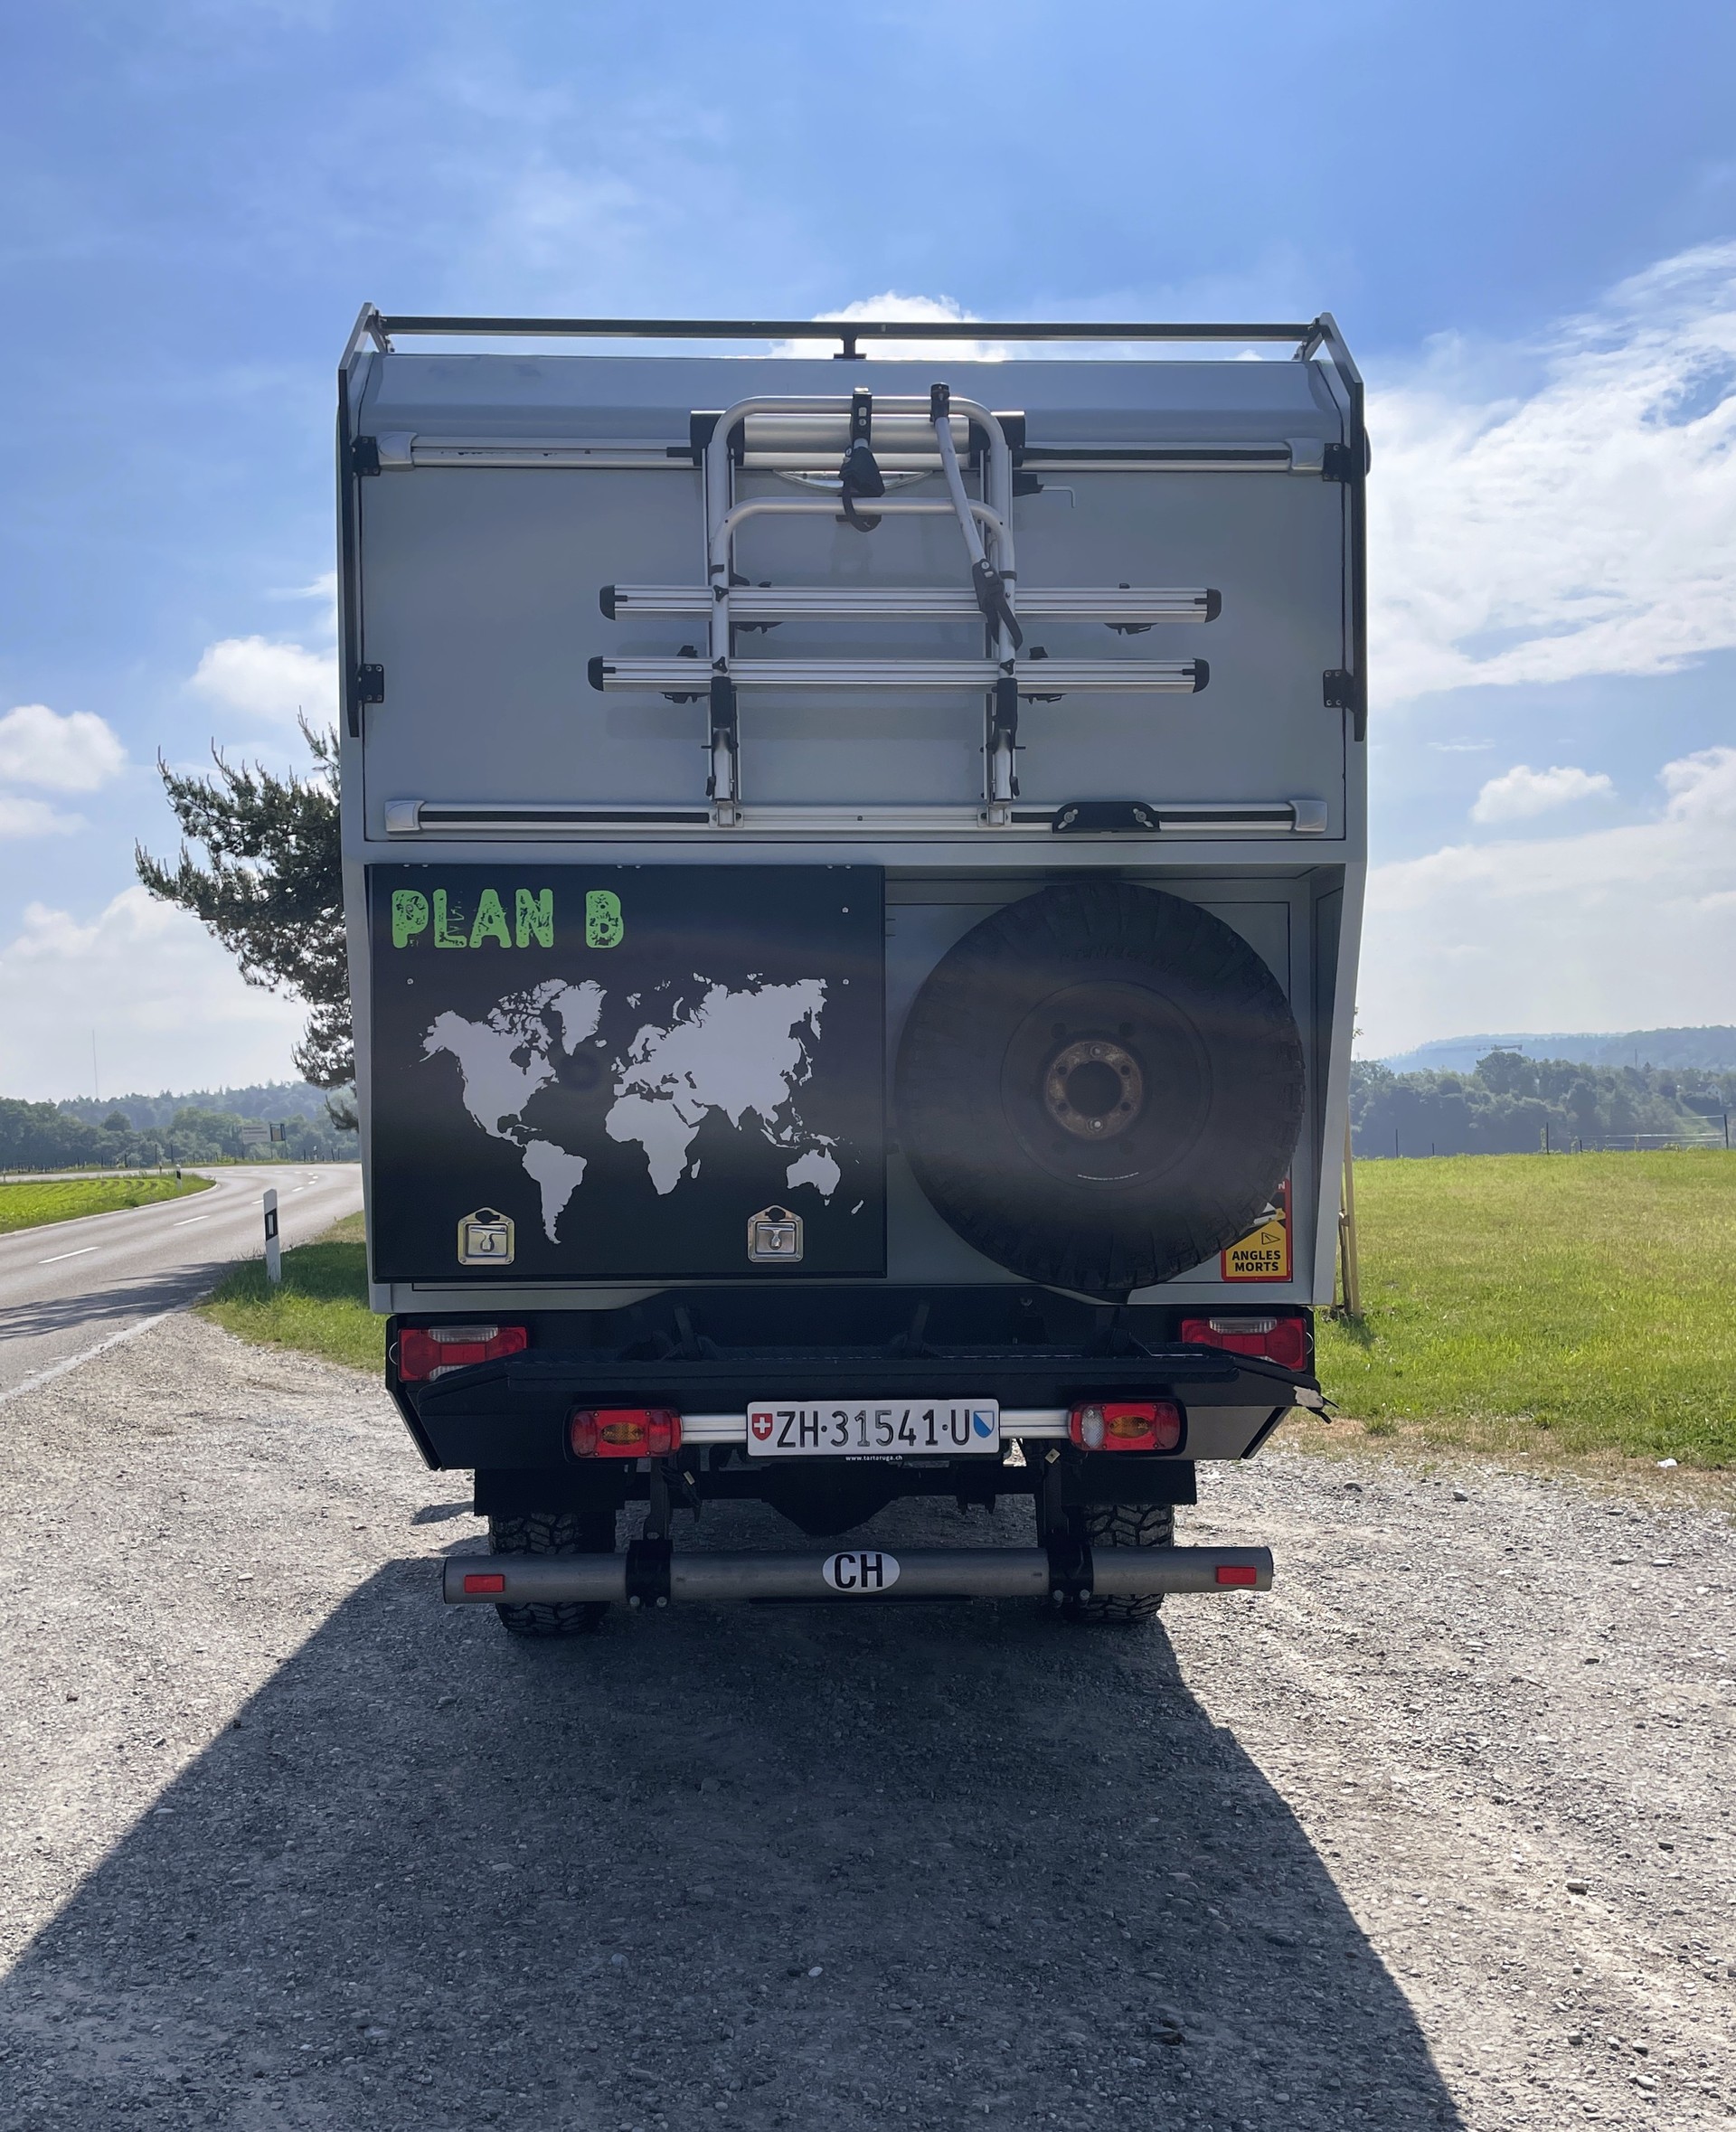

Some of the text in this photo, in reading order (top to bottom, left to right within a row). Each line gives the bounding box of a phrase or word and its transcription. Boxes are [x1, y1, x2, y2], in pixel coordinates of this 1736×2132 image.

[392, 888, 624, 948] PLAN B
[1231, 1250, 1281, 1261] ANGLES
[1234, 1262, 1279, 1272] MORTS
[834, 1553, 883, 1589] CH
